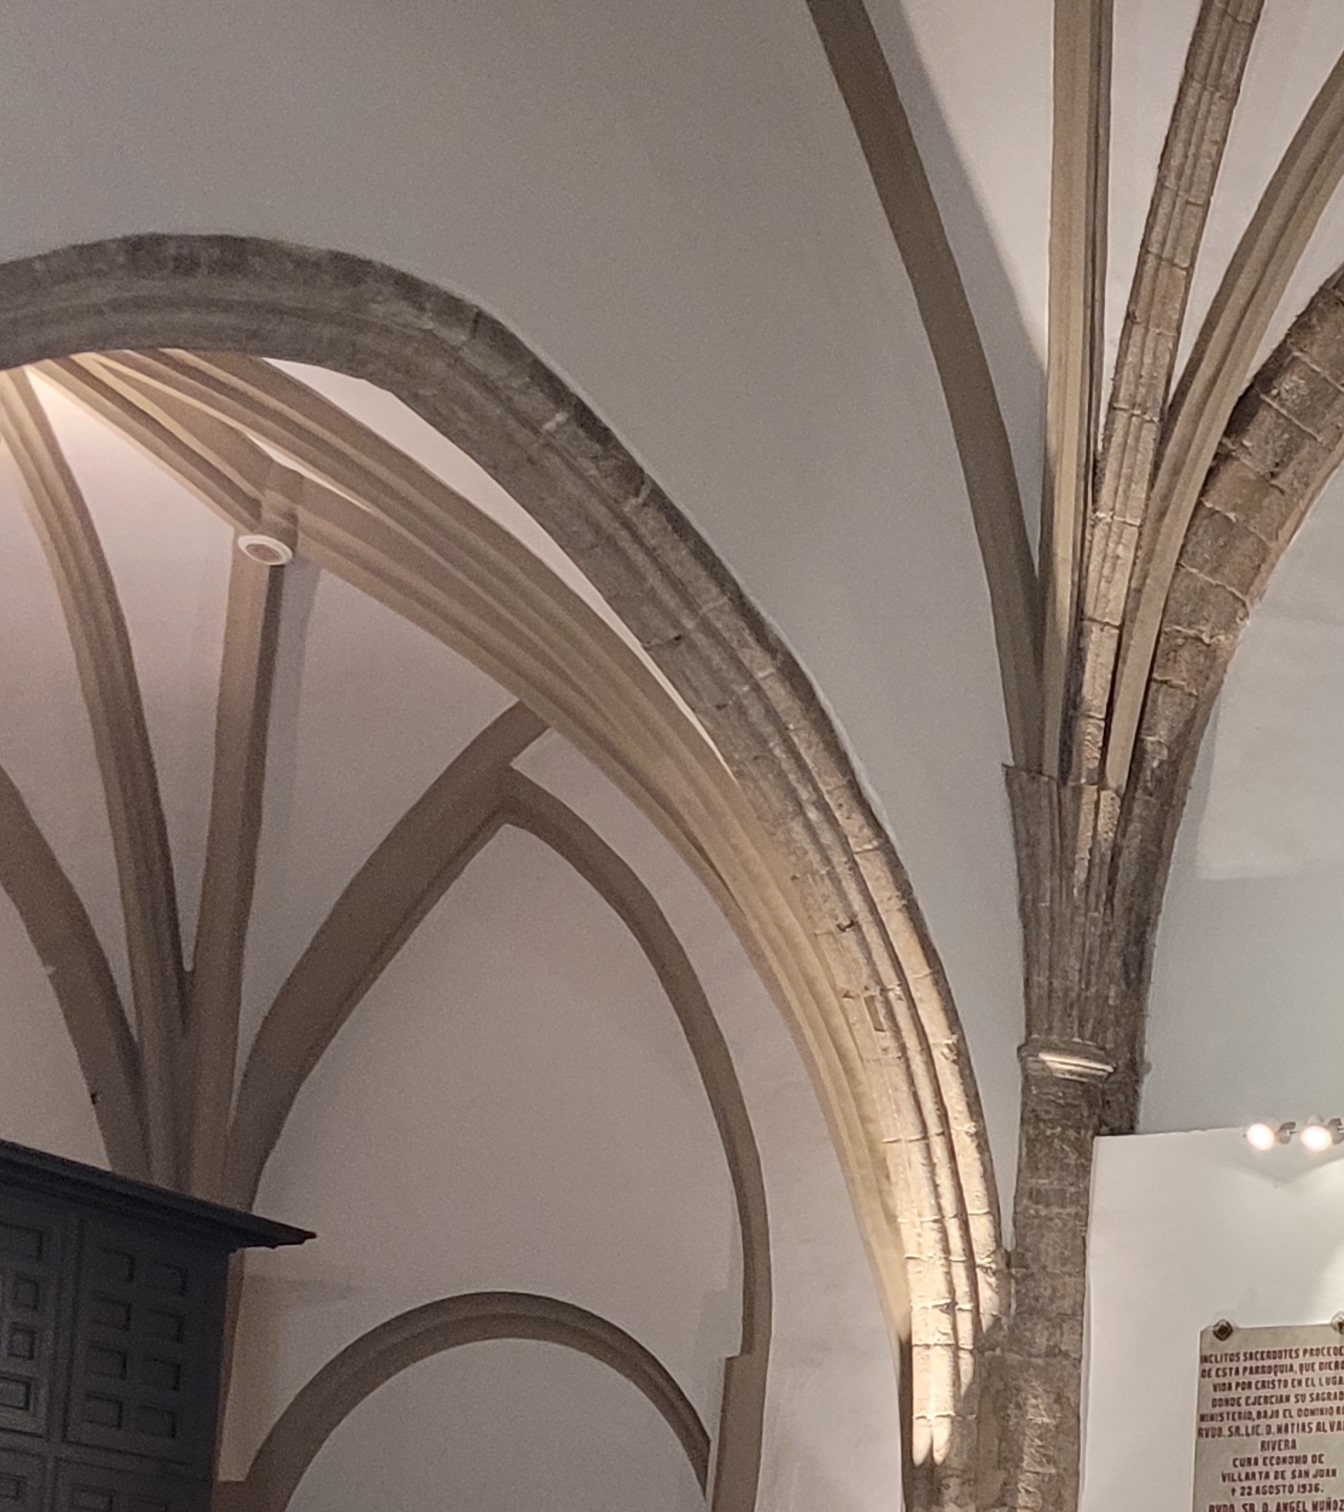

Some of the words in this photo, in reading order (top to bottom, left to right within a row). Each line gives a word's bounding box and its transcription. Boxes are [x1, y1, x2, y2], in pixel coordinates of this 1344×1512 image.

[1243, 1349, 1300, 1362] SACERDOTES
[1216, 1367, 1240, 1378] ESTA
[1299, 1362, 1316, 1375] QUE
[1235, 1381, 1252, 1391] POR
[1255, 1379, 1289, 1390] CRISTO
[1291, 1378, 1302, 1388] EN
[1305, 1377, 1316, 1388] EL
[1212, 1397, 1242, 1408] DONDE
[1294, 1393, 1306, 1404] SU
[1283, 1409, 1294, 1419] EL
[1260, 1438, 1297, 1452] RIVERA
[1233, 1457, 1259, 1468] CURA
[1263, 1454, 1308, 1467] ECONOMO
[1311, 1453, 1324, 1464] DE
[1222, 1471, 1270, 1483] VILLARTA
[1274, 1470, 1287, 1481] DE
[1291, 1469, 1310, 1480] SAN
[1313, 1468, 1337, 1479] JUAN
[1240, 1486, 1253, 1496] 22
[1255, 1484, 1294, 1496] AGOSTO
[1312, 1497, 1344, 1512] MUÑOZ
